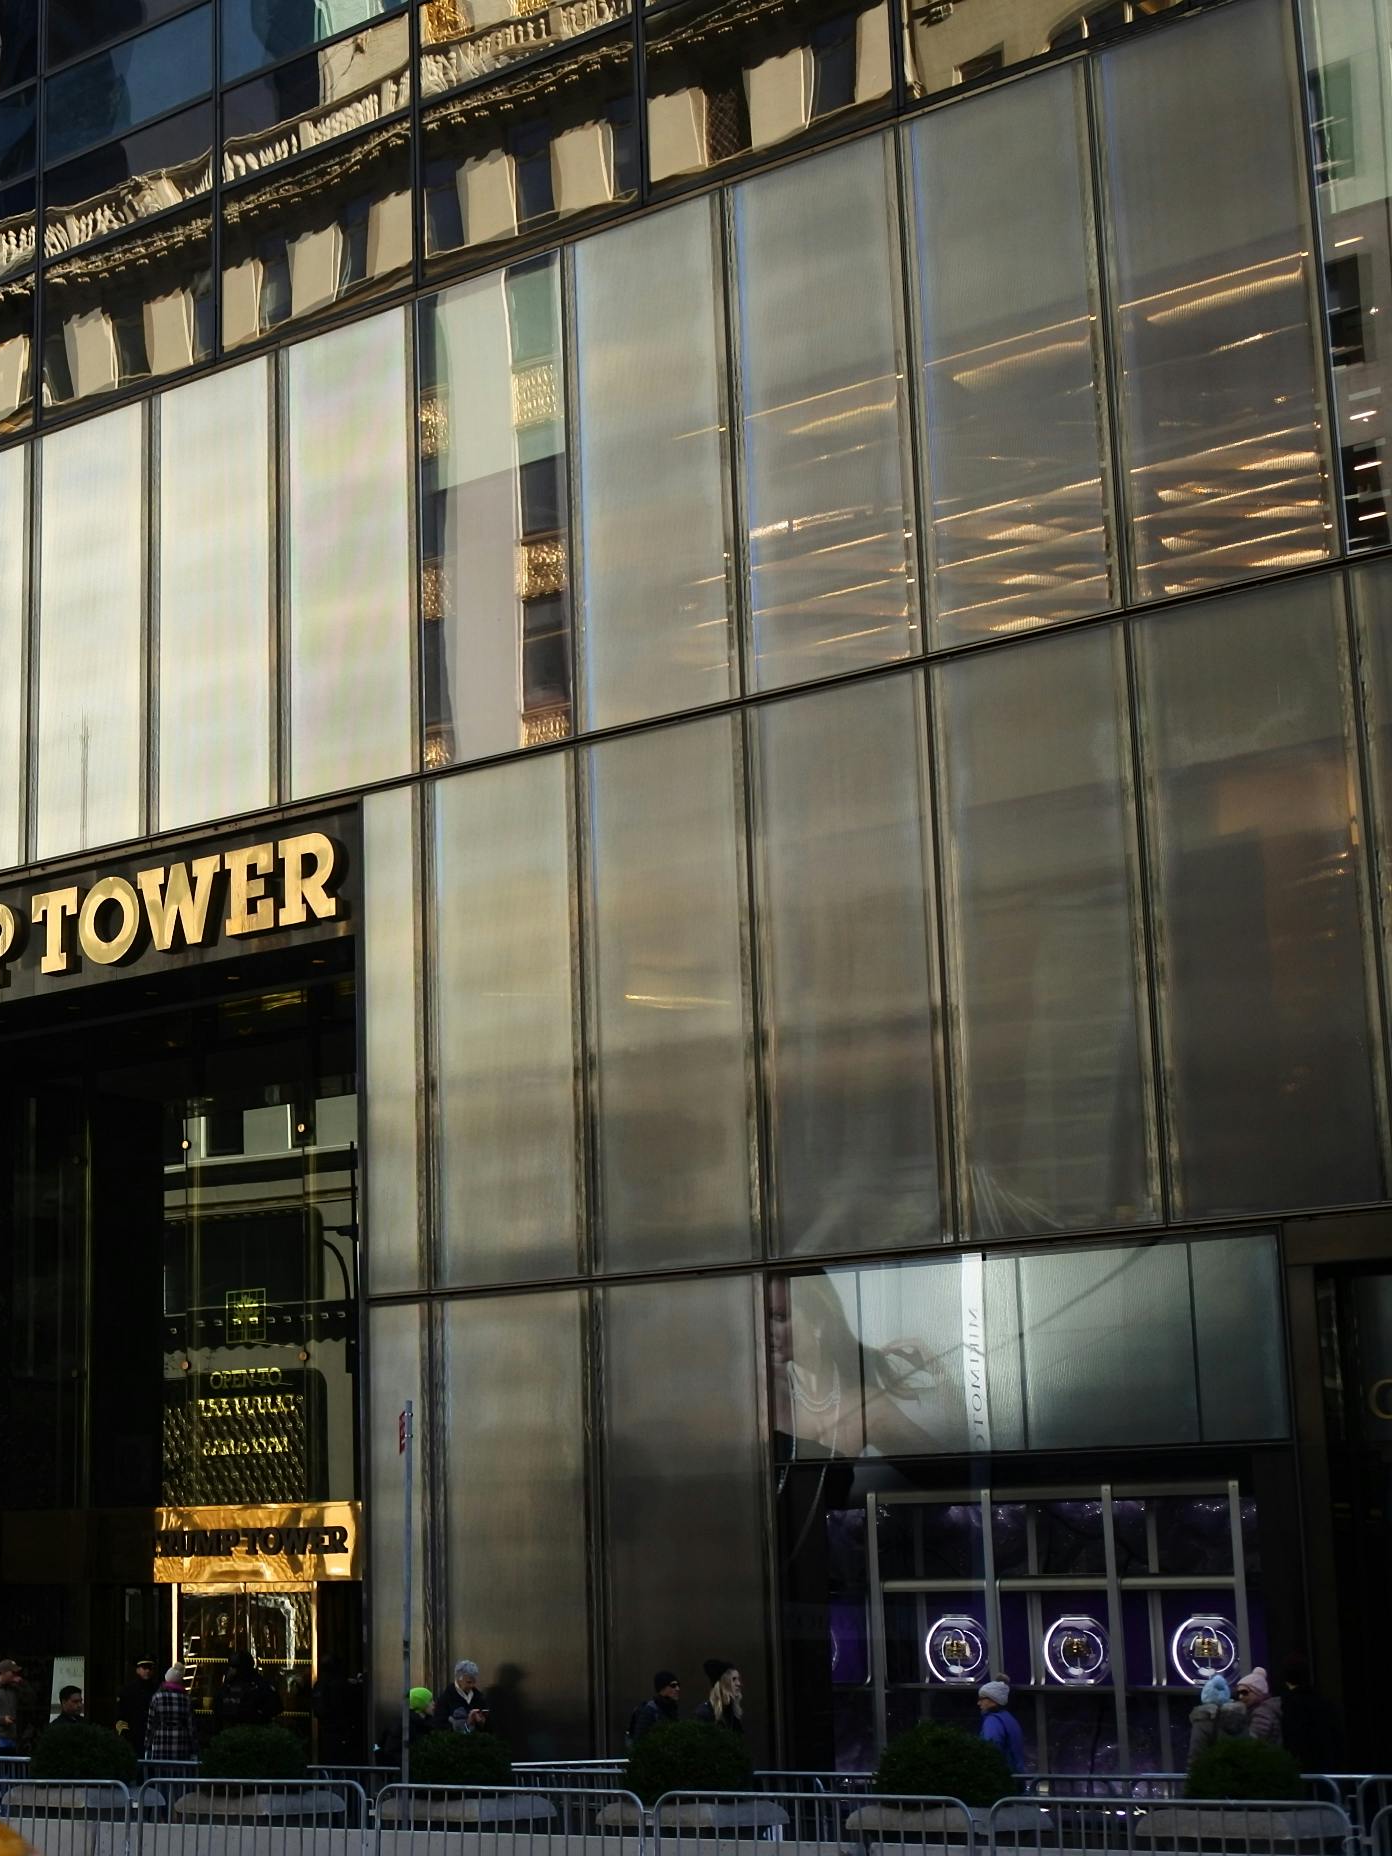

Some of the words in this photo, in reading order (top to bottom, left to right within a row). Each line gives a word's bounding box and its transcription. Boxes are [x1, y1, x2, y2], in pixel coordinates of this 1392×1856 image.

[32, 832, 336, 974] TOWER
[210, 1369, 255, 1390] OPEN
[256, 1367, 282, 1387] TO
[243, 1525, 349, 1556] TOWER
